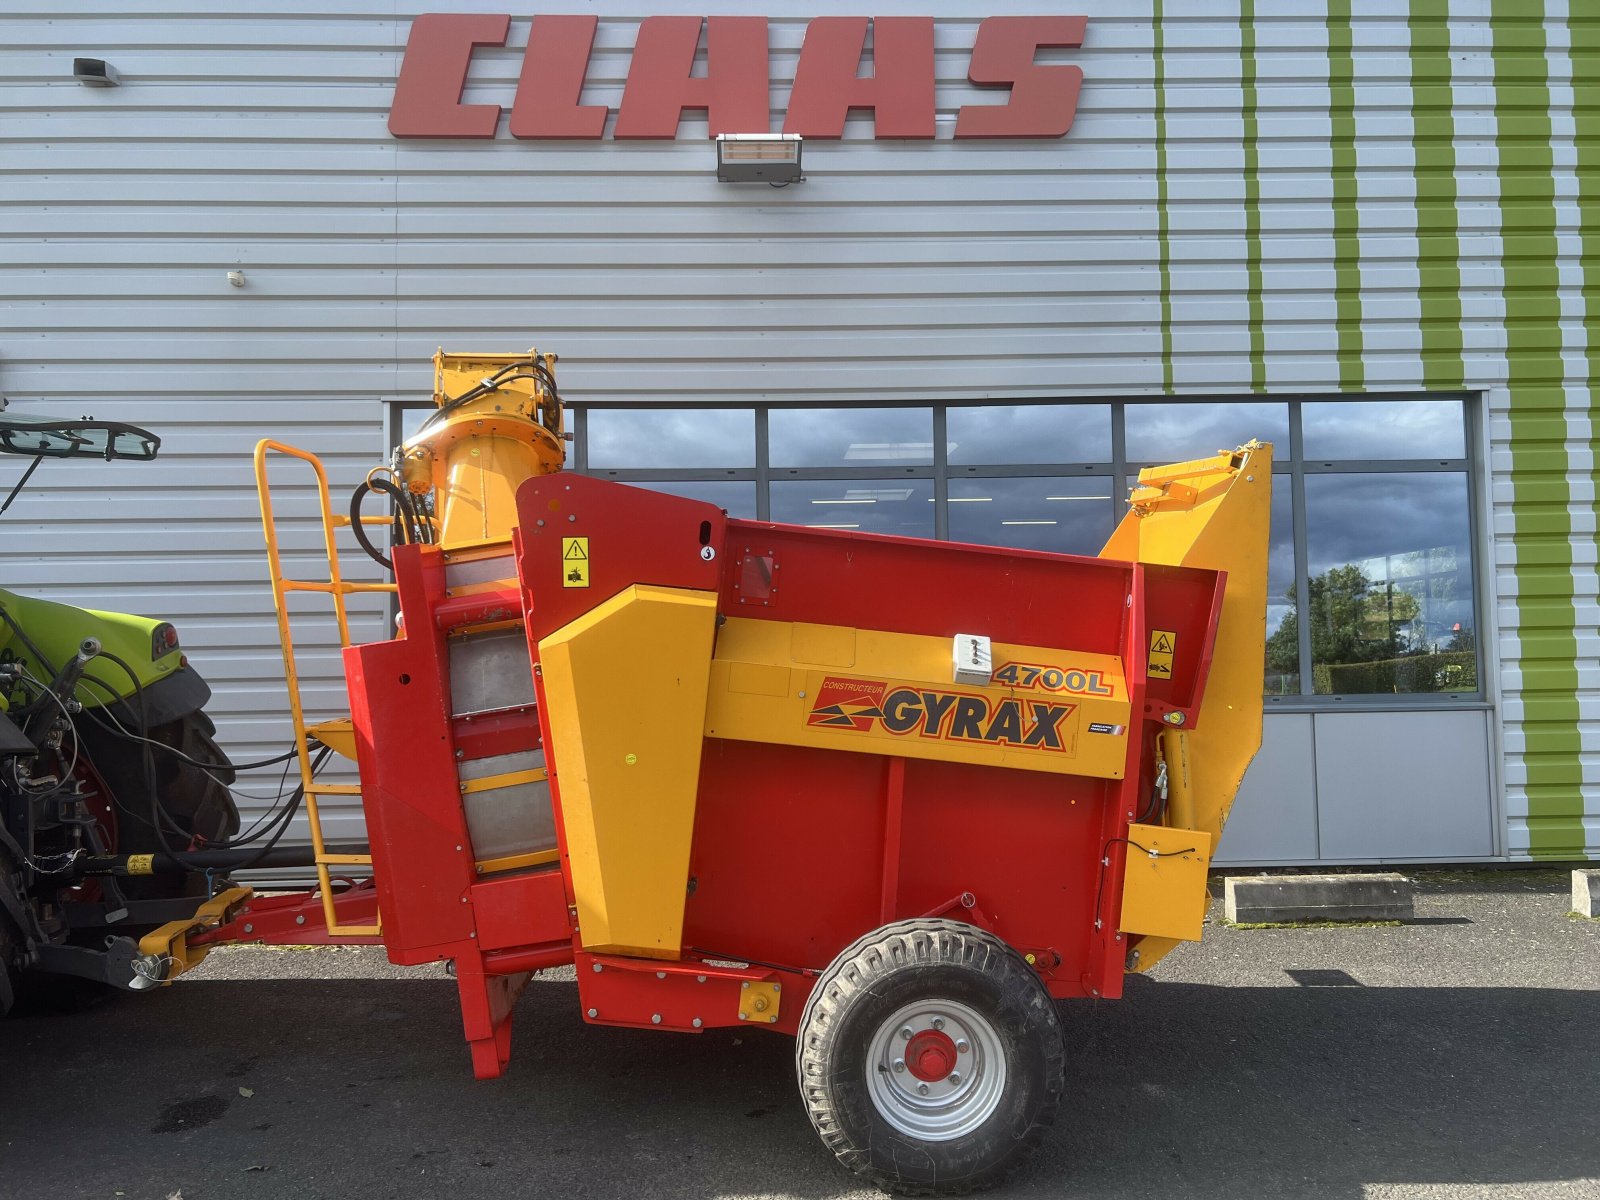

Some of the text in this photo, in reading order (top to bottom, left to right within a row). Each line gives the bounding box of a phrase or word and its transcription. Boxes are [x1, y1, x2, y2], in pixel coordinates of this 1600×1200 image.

[387, 13, 1089, 140] CLAAS
[823, 681, 884, 693] CONSTRUCTEUR
[995, 664, 1109, 694] 4700L
[881, 688, 1071, 749] GYRAX
